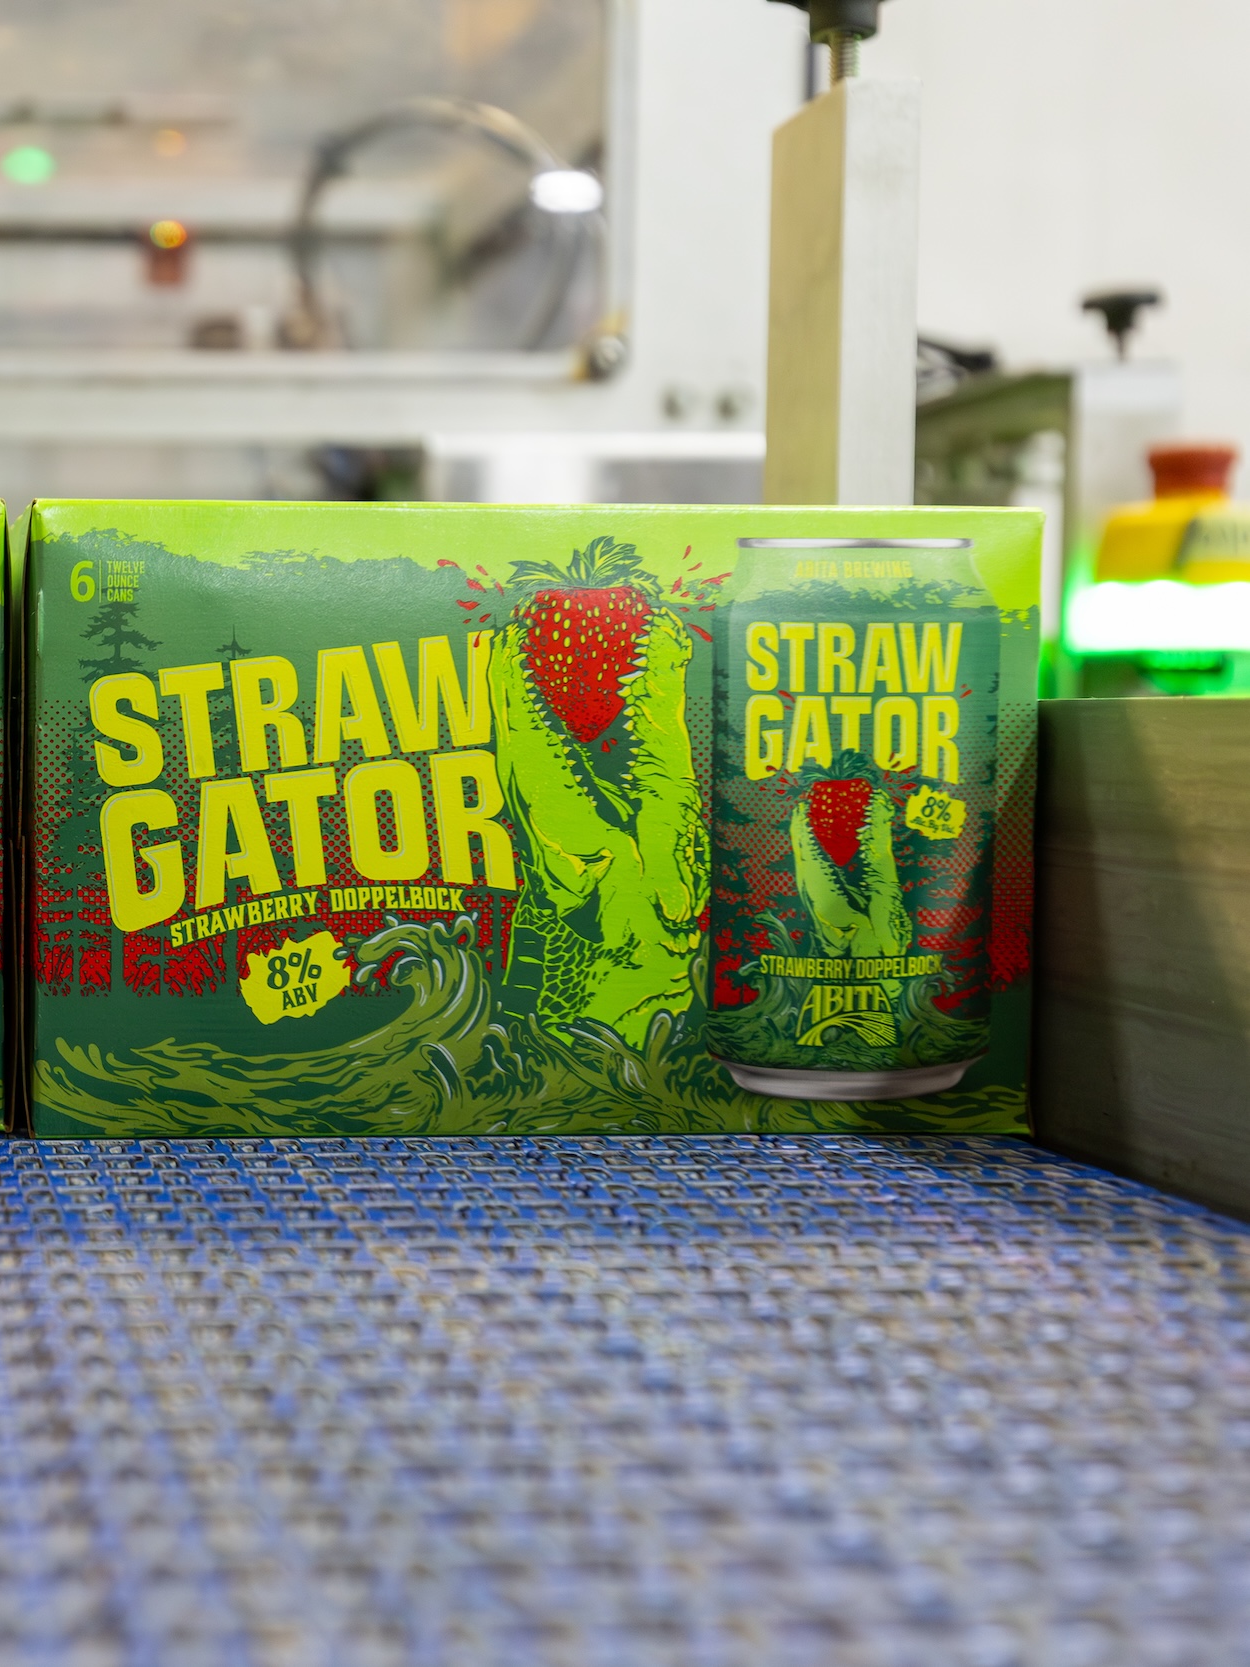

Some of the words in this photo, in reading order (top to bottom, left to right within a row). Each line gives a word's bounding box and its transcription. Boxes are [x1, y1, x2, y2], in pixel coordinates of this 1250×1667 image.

[70, 560, 96, 602] 6
[107, 560, 146, 574] TWELVE
[107, 574, 140, 588] OUNCE
[795, 561, 839, 578] ABITA
[843, 561, 914, 578] BREWING
[107, 588, 134, 602] CANS
[746, 621, 963, 693] STRAW
[89, 630, 494, 787] STRAW
[745, 694, 959, 784] GATOR
[921, 796, 951, 821] 8%
[99, 749, 517, 933] GATOR
[170, 890, 319, 949] STRAWBERRY
[331, 886, 465, 914] DOPPELBOCK
[266, 948, 322, 991] 8%
[760, 954, 849, 979] STRAWBERRY
[855, 954, 944, 979] DOPPELBOCK
[281, 983, 319, 1012] ABV
[795, 985, 893, 1038] ABITA
